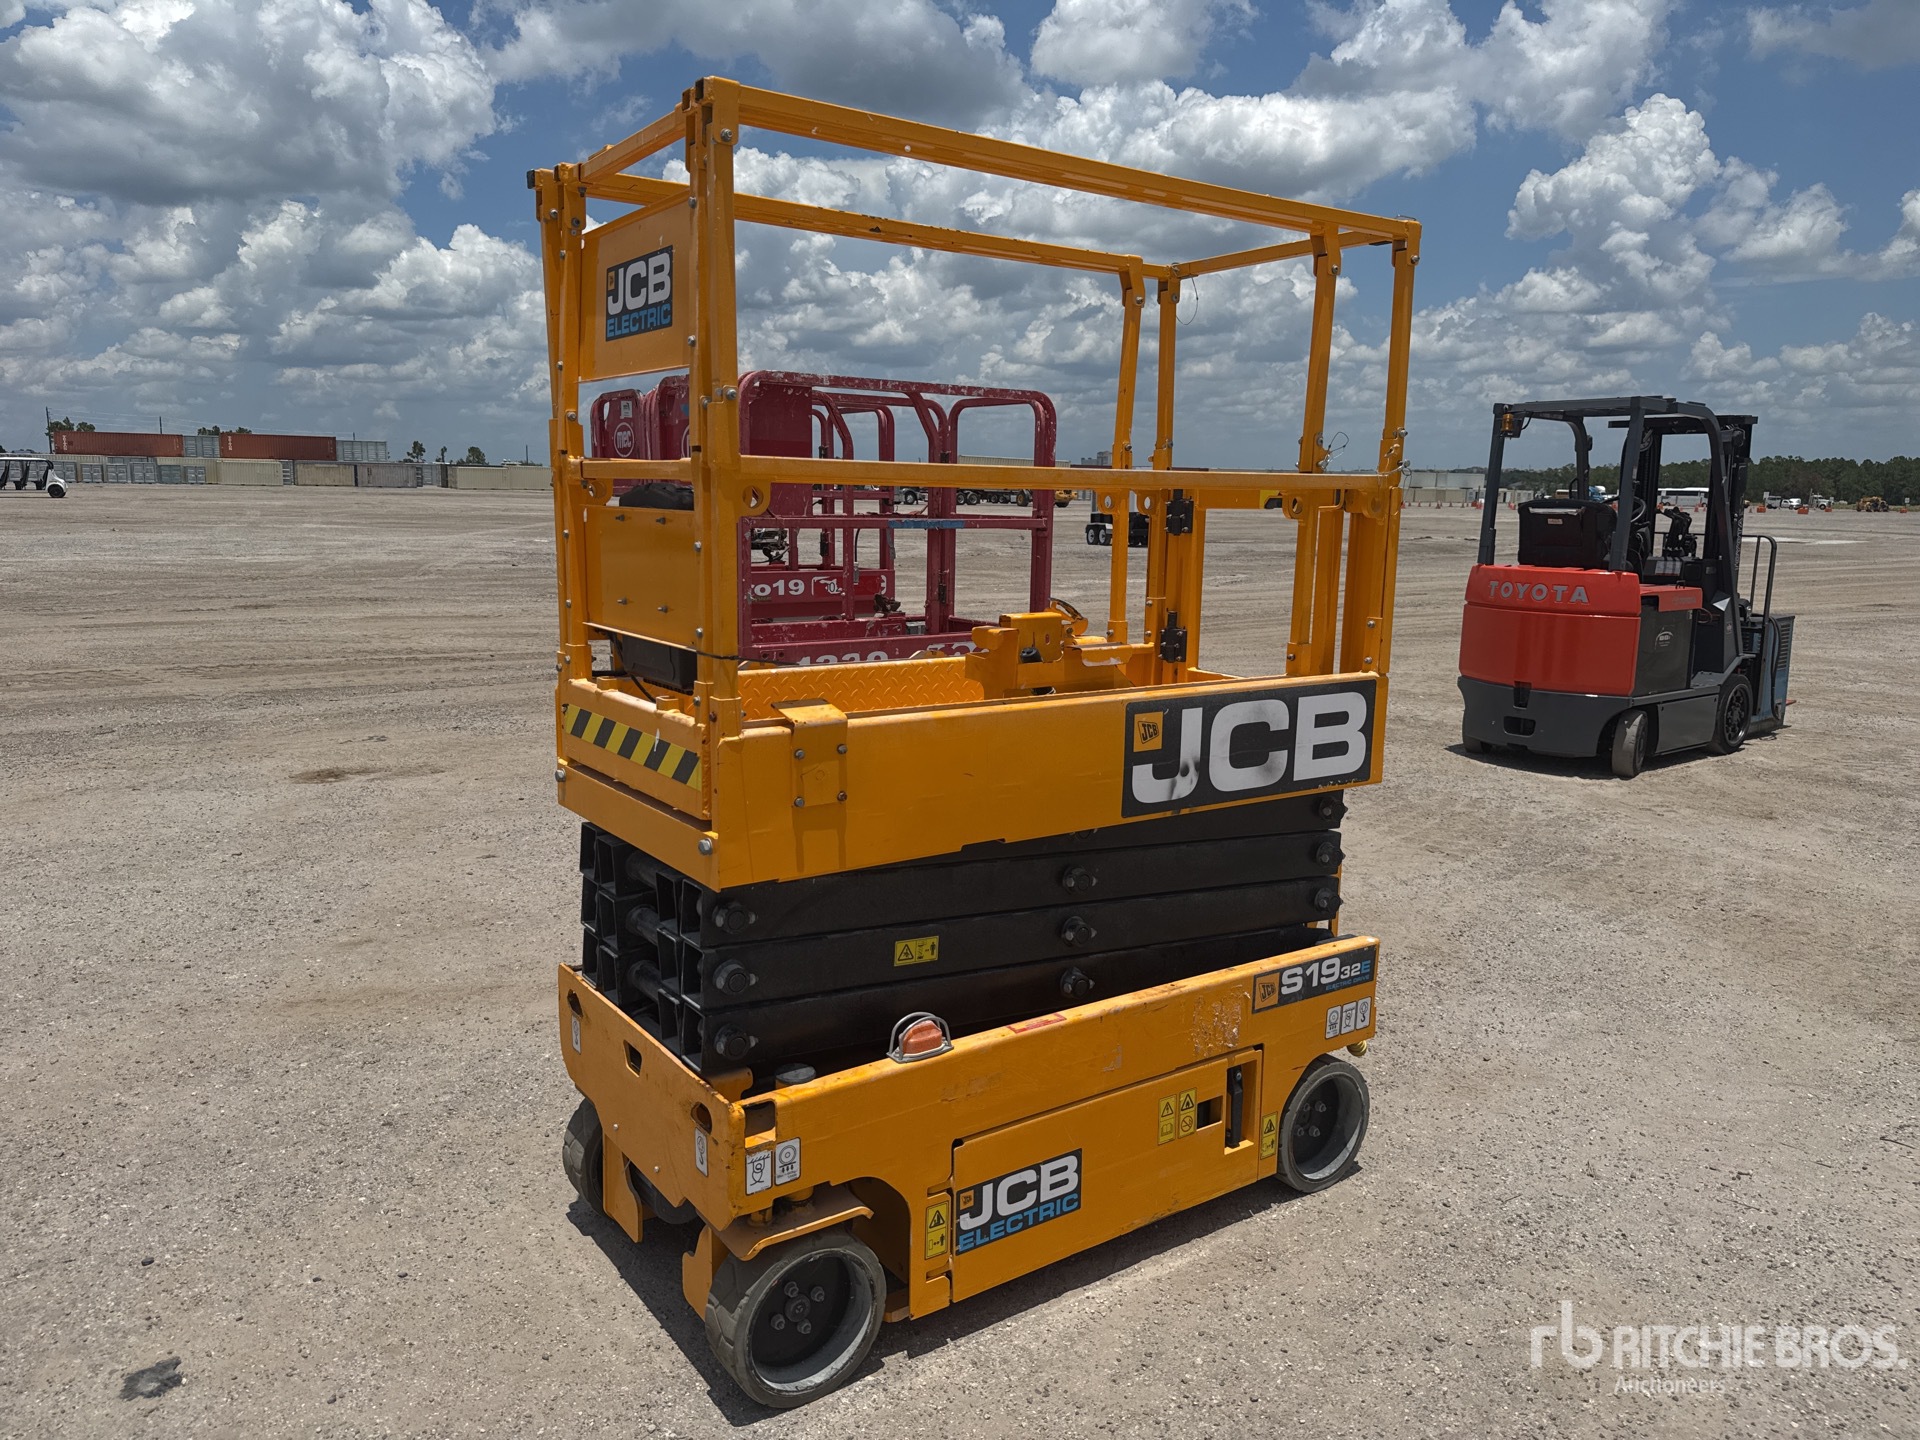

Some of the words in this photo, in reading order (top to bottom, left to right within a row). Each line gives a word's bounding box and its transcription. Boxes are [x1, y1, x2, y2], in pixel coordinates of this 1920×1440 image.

[608, 253, 671, 315] JCB
[607, 303, 671, 337] ELECTRIC
[1489, 581, 1589, 603] TOYOTA
[1132, 692, 1367, 803] JCB
[1141, 722, 1159, 742] JCB
[959, 1155, 1079, 1231] JCB
[959, 1193, 1079, 1252] ELECTRIC
